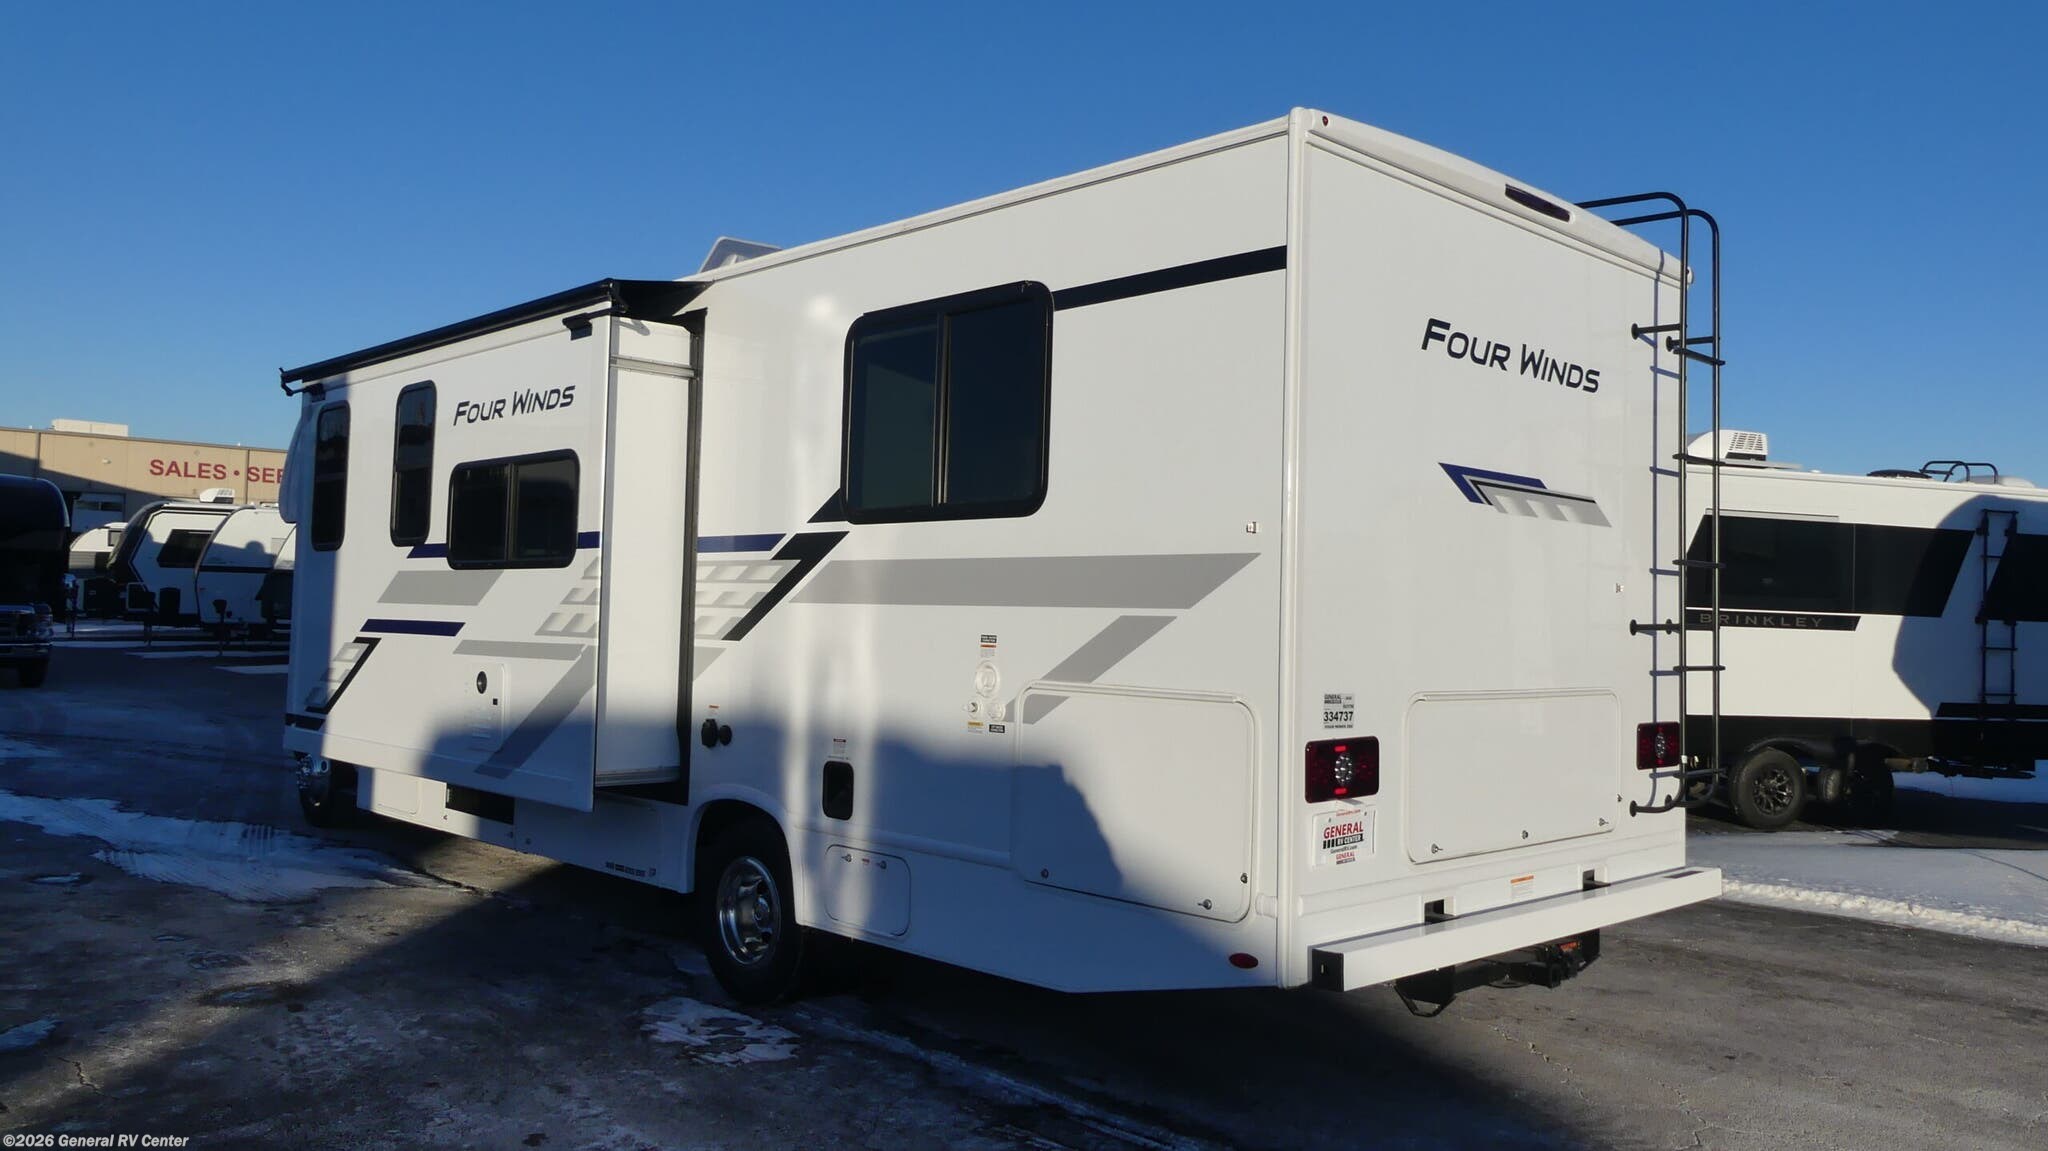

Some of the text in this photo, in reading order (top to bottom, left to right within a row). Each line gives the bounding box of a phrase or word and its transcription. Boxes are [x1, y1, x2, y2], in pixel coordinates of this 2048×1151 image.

[1421, 318, 1601, 393] FOUR WINDS
[453, 385, 576, 426] FOUR WINDS
[149, 459, 227, 480] SALES
[1699, 613, 1823, 628] BRINKLEY
[1323, 711, 1354, 722] 334737
[1323, 820, 1364, 839] GENERAL
